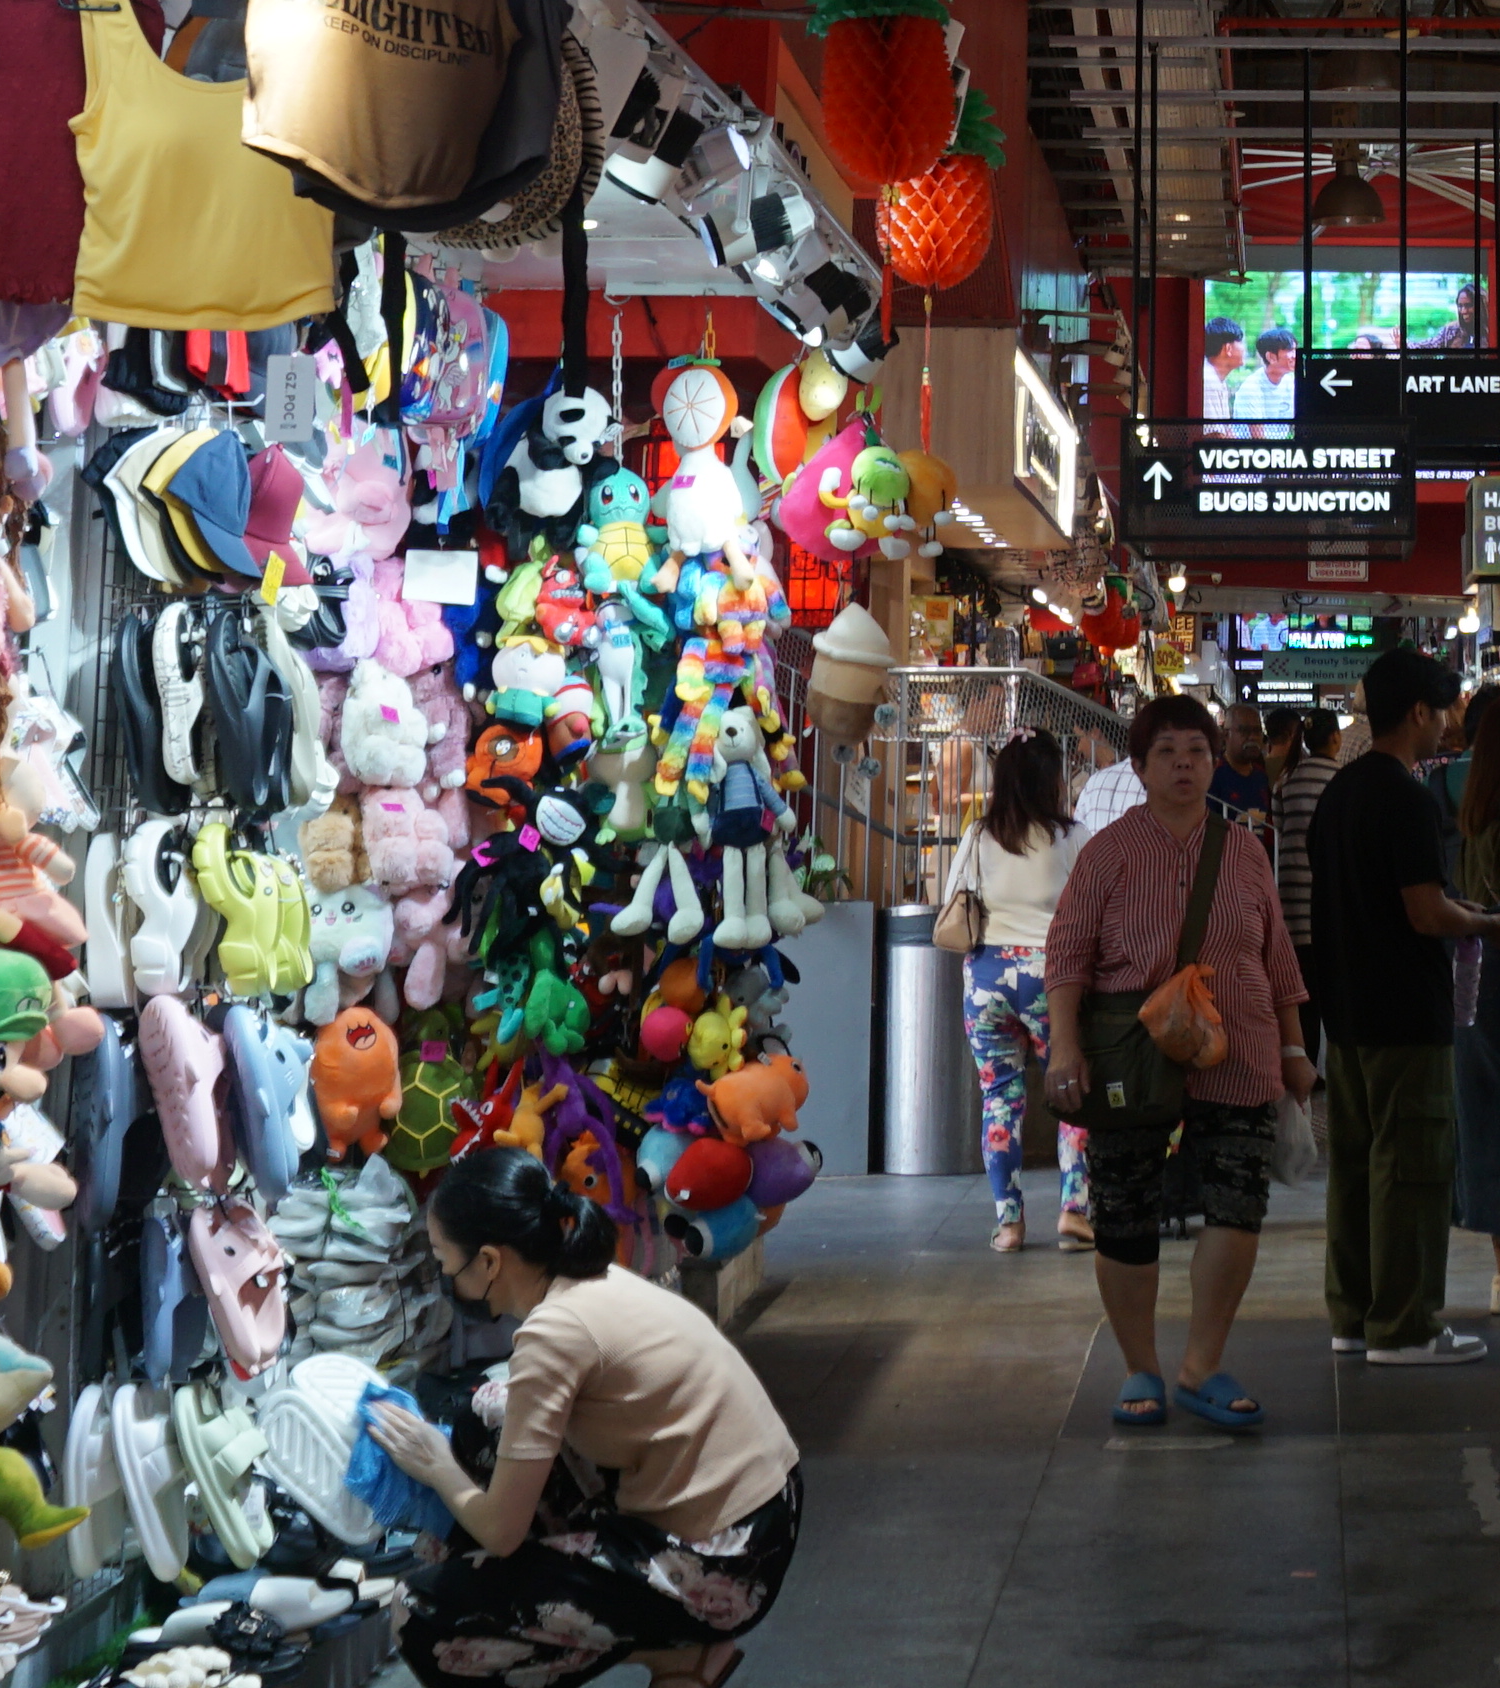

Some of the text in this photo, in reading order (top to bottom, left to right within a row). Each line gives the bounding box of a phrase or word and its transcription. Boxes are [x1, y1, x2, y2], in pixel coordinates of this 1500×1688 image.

[323, 15, 360, 35] KEEP
[362, 30, 380, 49] ON
[1405, 375, 1446, 394] ART
[1199, 448, 1396, 469] VICTORIA STREET
[1199, 491, 1391, 512] BUGIS JUNCTION
[1303, 656, 1339, 667] Beauty
[1295, 670, 1337, 680] Fashion
